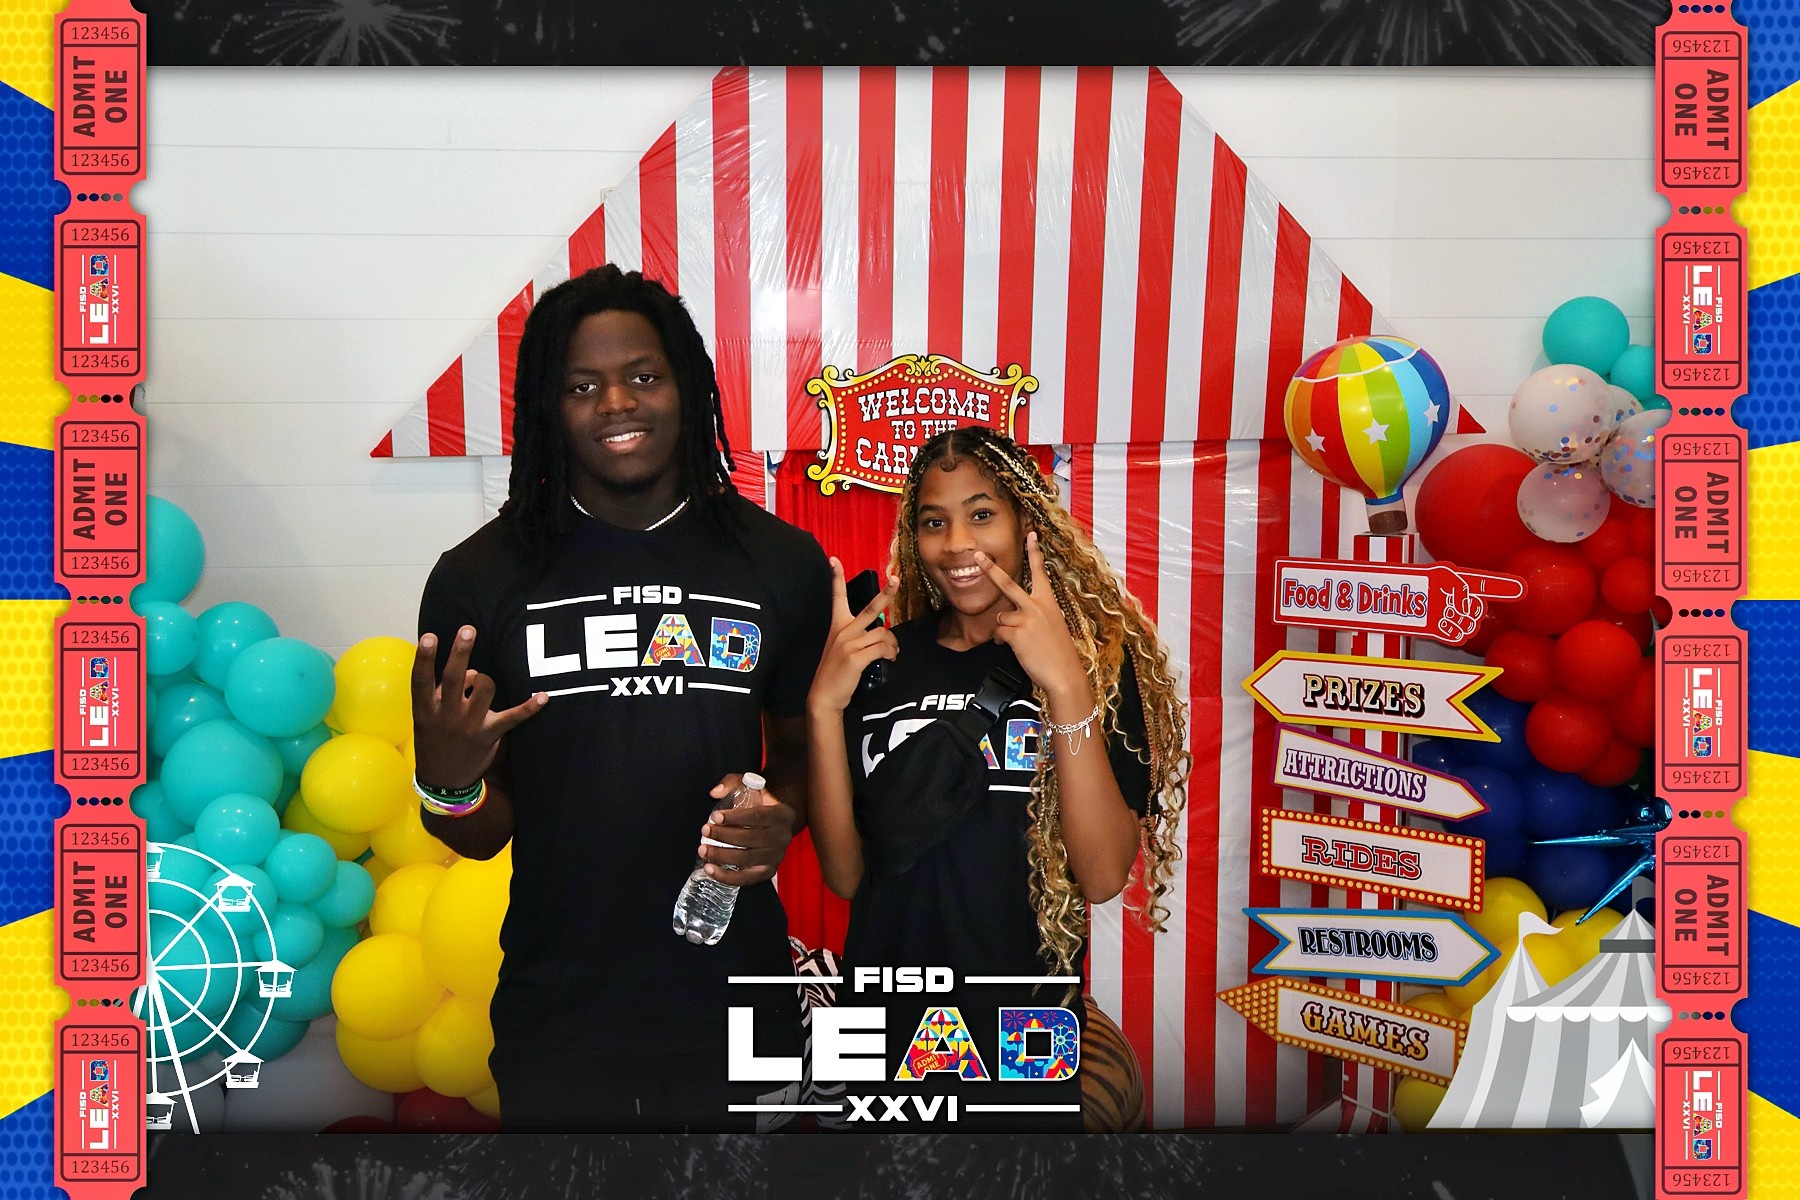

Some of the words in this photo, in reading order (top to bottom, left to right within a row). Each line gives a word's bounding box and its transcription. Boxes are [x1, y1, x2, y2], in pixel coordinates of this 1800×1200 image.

[858, 387, 990, 422] WELCOME
[891, 420, 916, 439] TO
[855, 437, 918, 475] CAR
[613, 585, 682, 605] FISD
[1282, 578, 1332, 611] Food
[1337, 580, 1353, 611] &
[1357, 583, 1428, 618] Drinks
[526, 613, 761, 677] LEAD
[610, 675, 684, 697] XXVI
[1303, 674, 1425, 718] PRIZES
[1282, 749, 1427, 802] ATTRACTIONS
[1302, 835, 1421, 880] RIDES
[1298, 927, 1438, 962] RESTROOMS
[1301, 1002, 1429, 1061] GAMES
